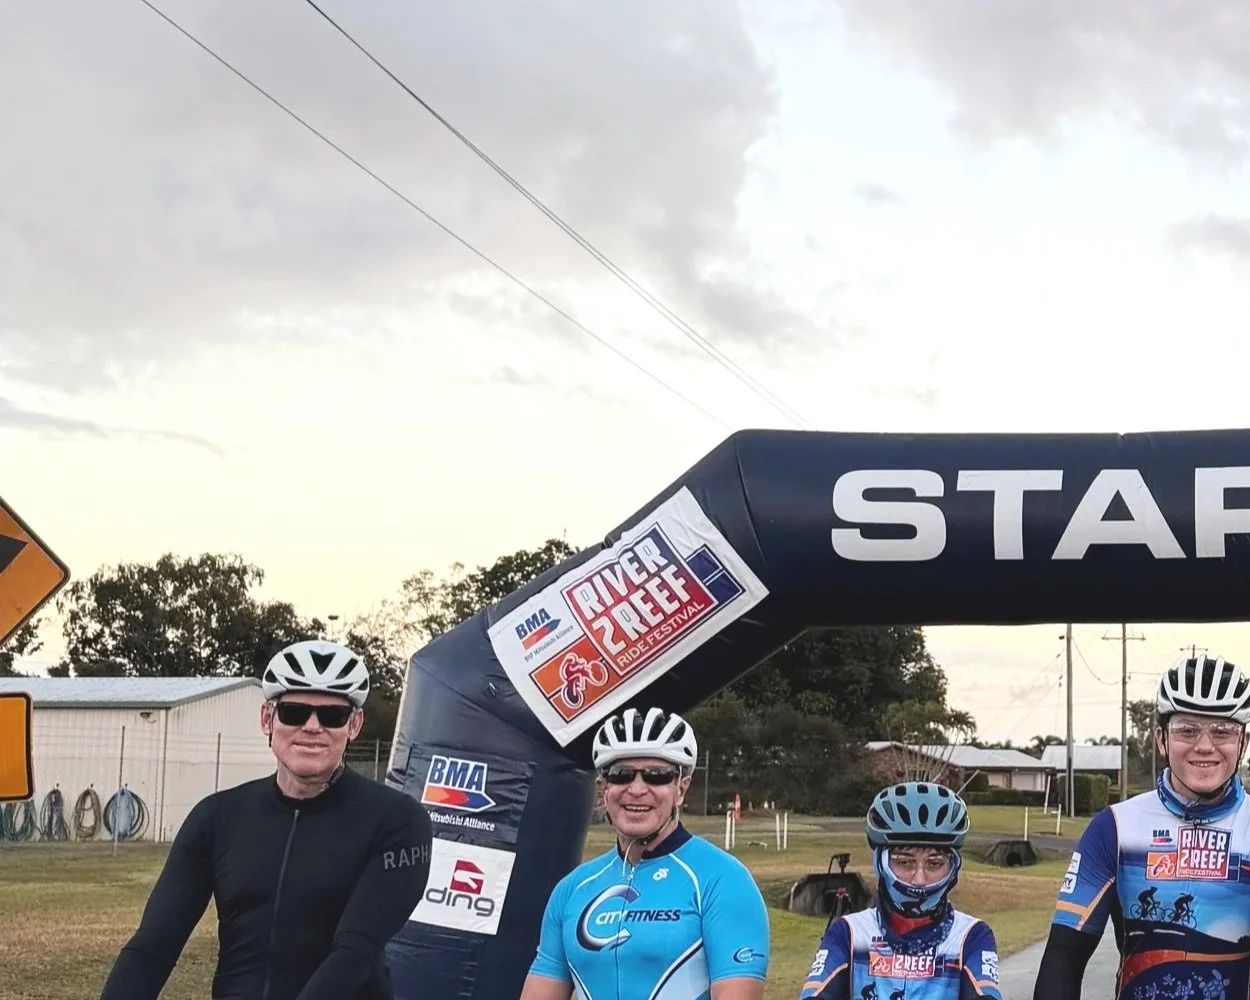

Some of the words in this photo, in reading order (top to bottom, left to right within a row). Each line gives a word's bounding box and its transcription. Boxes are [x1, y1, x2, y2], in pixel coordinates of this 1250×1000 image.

[572, 534, 668, 621] RIVER
[516, 608, 551, 640] BMA
[591, 563, 692, 655] 2REEF
[616, 641, 649, 668] RIDE
[647, 602, 705, 648] FESTIVAL
[429, 757, 485, 791] BMA
[463, 818, 495, 832] Alliance
[1153, 829, 1170, 837] BMA
[1182, 829, 1227, 850] RIVER
[1180, 849, 1226, 869] 2REEF
[425, 887, 495, 917] ding
